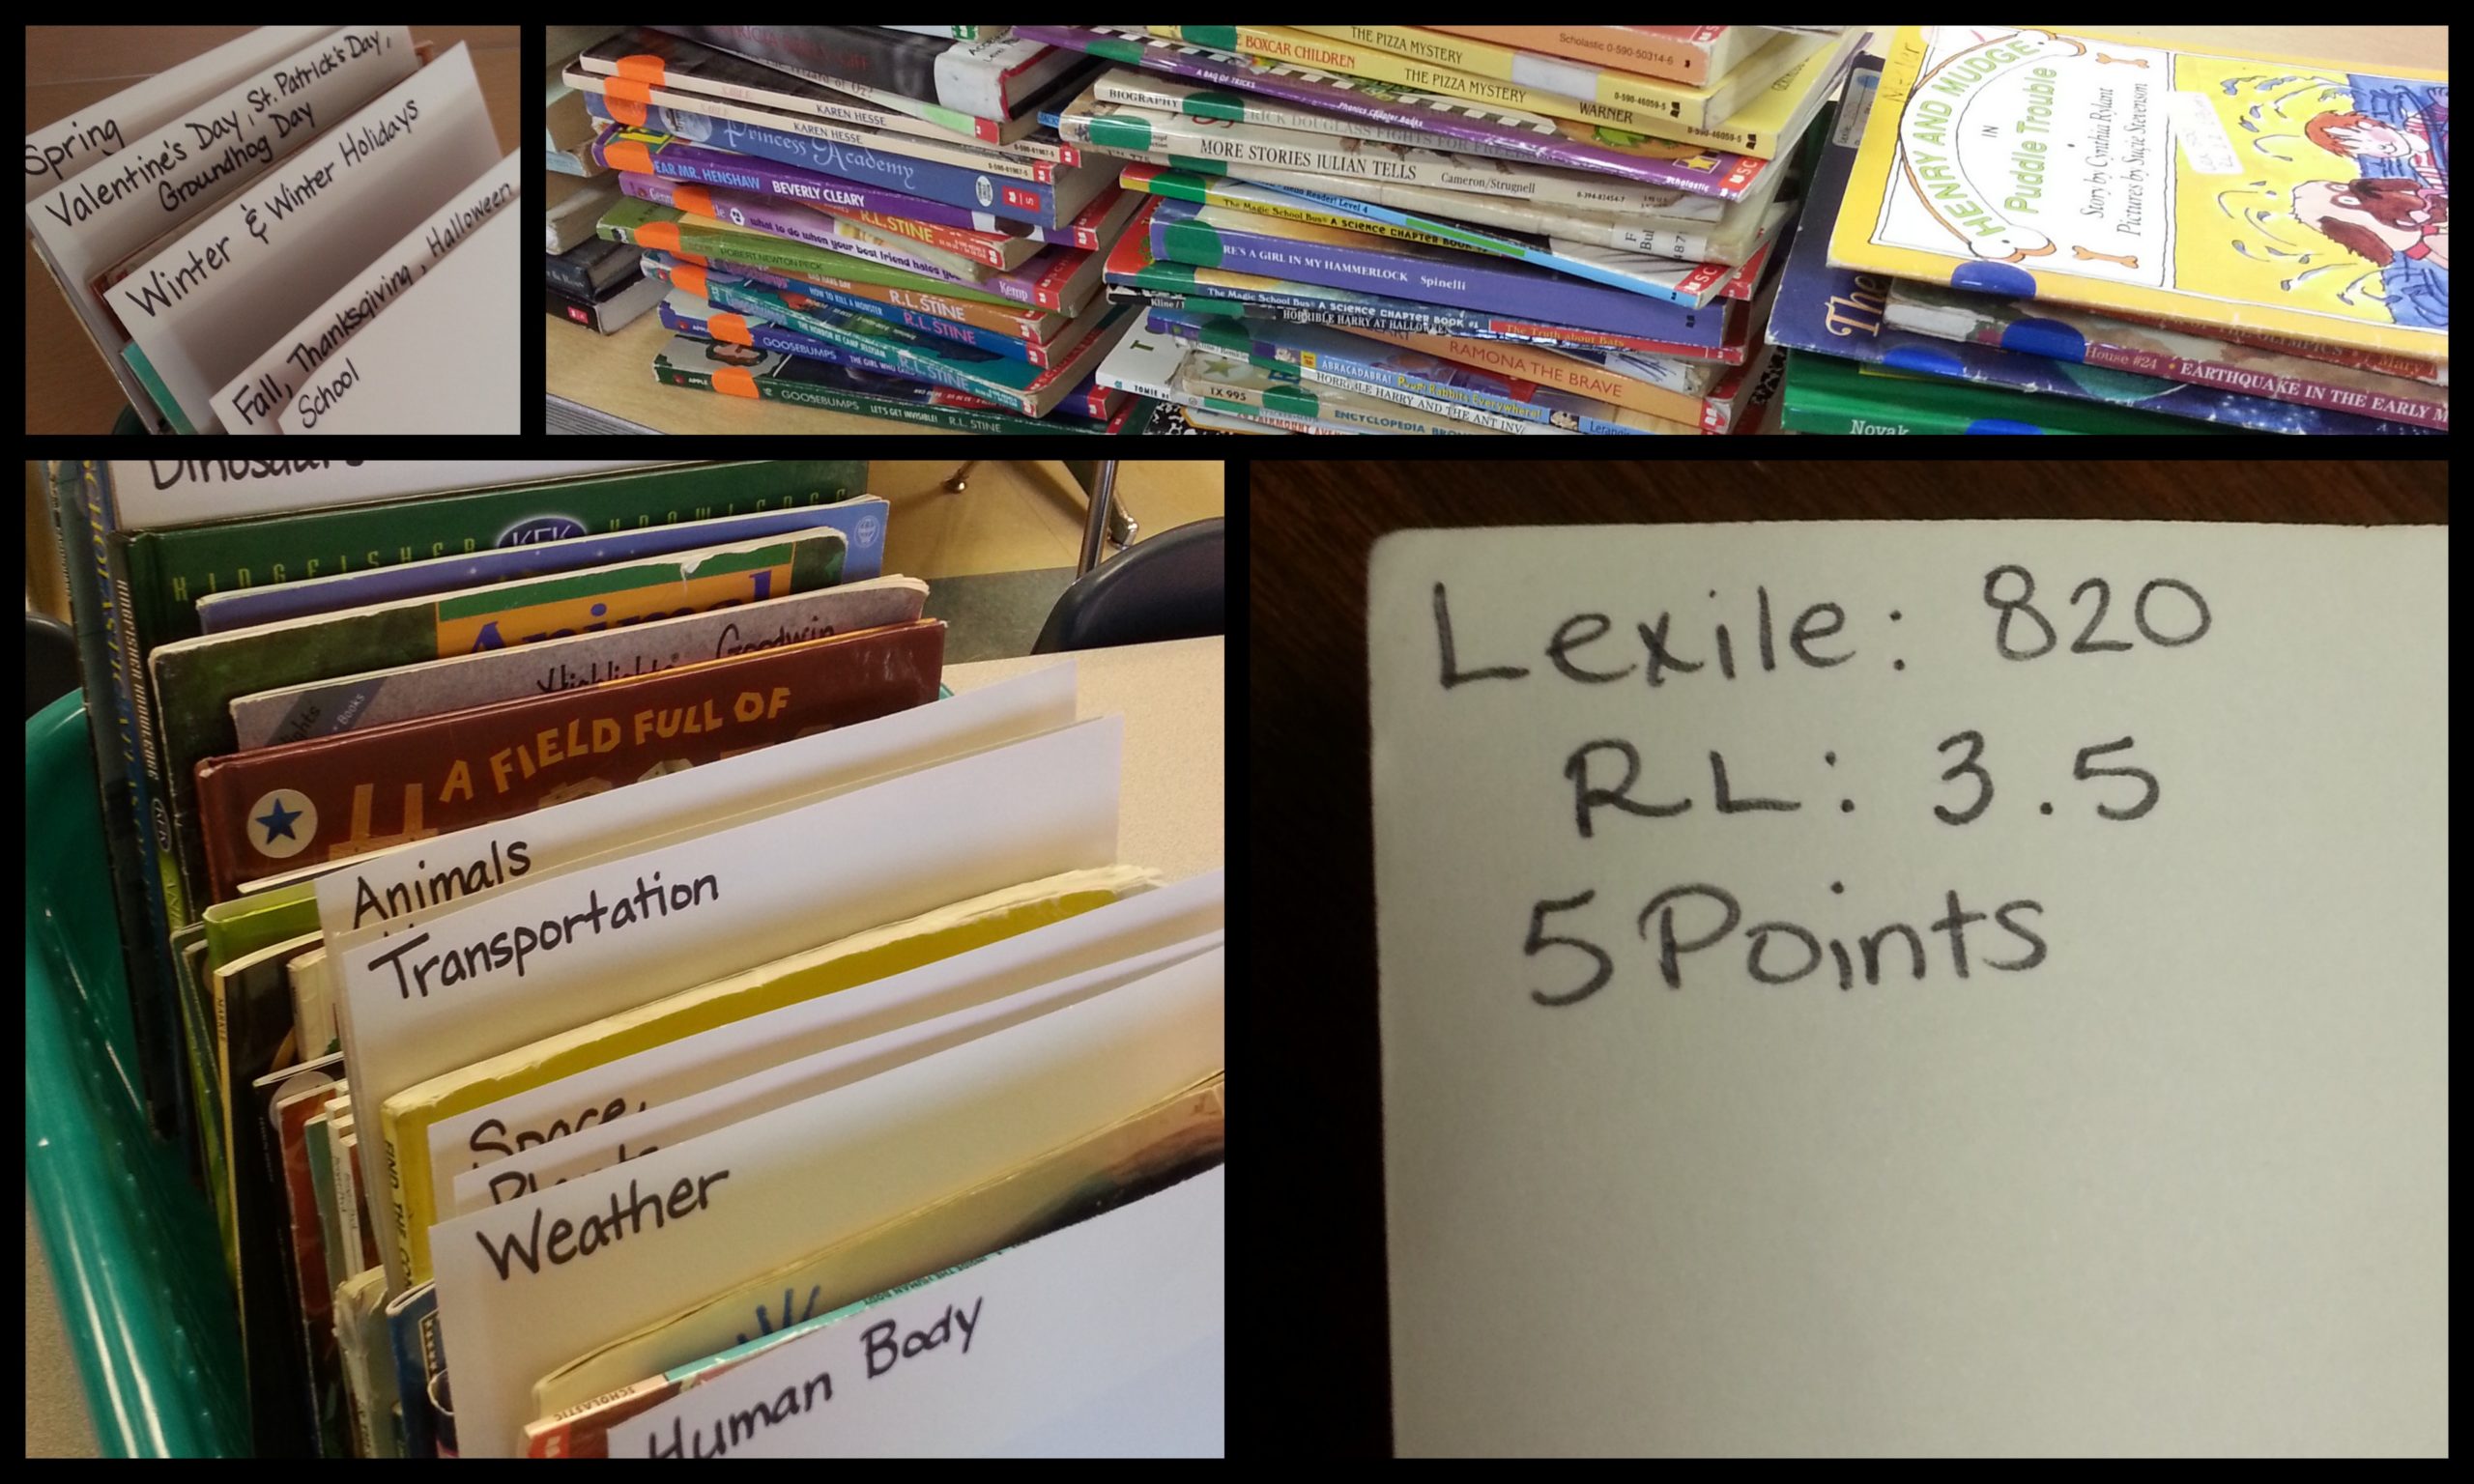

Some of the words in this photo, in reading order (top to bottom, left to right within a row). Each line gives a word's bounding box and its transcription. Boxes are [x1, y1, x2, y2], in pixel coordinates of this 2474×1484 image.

[1351, 27, 1373, 43] THE
[1376, 33, 1406, 51] PIZZA
[1410, 41, 1463, 65] MYSTERY
[1560, 33, 1604, 52] Scholastic
[1606, 43, 1674, 66] 0-590-50314-6
[1931, 40, 2040, 98] MUDGE
[1246, 36, 1291, 55] BOXCAR
[1295, 45, 1355, 69] CHILDREN
[1404, 68, 1428, 84] THE
[1433, 73, 1465, 92] PIZZA
[1468, 80, 1527, 104] MYSTERY
[1579, 101, 1633, 124] WARNER
[2016, 67, 2057, 133] Trouble
[2089, 87, 2117, 122] Rylant
[793, 122, 828, 137] KAREN
[831, 129, 863, 145] HESSE
[816, 104, 851, 121] KAREN
[855, 112, 887, 127] HESSE
[1109, 89, 1179, 107] BIOGRAPHY
[1292, 113, 1371, 136] DOUGLASS
[1377, 127, 1431, 146] FIGHTS
[1231, 77, 1255, 89] TRICKS
[1666, 176, 1710, 192] Scholastic
[1913, 100, 1952, 146] AND
[1981, 125, 1999, 138] IN
[2123, 83, 2148, 135] Stevenson
[24, 118, 127, 182] Spring
[44, 140, 187, 228] Valentine's
[246, 88, 279, 114] St.
[274, 44, 346, 99] Patrick's
[158, 137, 273, 214] Groundhog
[270, 101, 315, 143] Day
[724, 120, 806, 156] Princess
[811, 138, 916, 190] Academy
[2086, 124, 2114, 169] Cynthia
[678, 164, 701, 180] MR.
[703, 170, 760, 189] HENSHAW
[772, 181, 820, 200] BEVERLY
[822, 188, 865, 207] CLEARY
[1200, 139, 1244, 158] MORE
[1248, 146, 1311, 167] STORIES
[1317, 155, 1366, 175] JULIAN
[1372, 160, 1417, 180] TELLS
[1441, 171, 1537, 194] Cameron/Strugnell
[2003, 140, 2048, 214] Puddle
[2083, 167, 2113, 187] by
[2120, 167, 2149, 189] by
[126, 233, 234, 319] Winter
[241, 203, 270, 246] &
[267, 160, 335, 223] Winter
[338, 98, 420, 167] Holidays
[425, 180, 514, 258] Halloween
[1223, 199, 1240, 209] The
[1243, 202, 1270, 214] Magic
[1272, 207, 1303, 220] School
[1307, 189, 1338, 205] Reader!
[1338, 198, 1360, 213] Level
[1913, 151, 2006, 237] HENRY
[2080, 186, 2111, 219] Story
[2116, 190, 2143, 237] Pictures
[720, 247, 760, 263] ROBERT
[762, 253, 798, 267] NEWTON
[750, 218, 773, 230] what
[788, 226, 799, 238] do
[802, 231, 828, 245] when
[831, 240, 854, 252] your
[856, 243, 878, 258] best
[879, 250, 910, 268] friend
[912, 260, 940, 275] hates
[999, 280, 1028, 301] Kemp
[1259, 251, 1286, 264] GIRL
[1288, 254, 1302, 266] IN
[1305, 258, 1323, 269] MY
[1325, 260, 1408, 282] HAMMERLOCK
[1421, 275, 1466, 291] Spinelli
[809, 287, 824, 298] HOW
[835, 295, 848, 306] KILL
[855, 301, 883, 316] MONSTER
[933, 321, 976, 344] STINE
[920, 298, 965, 321] STINE
[1150, 298, 1174, 309] Kline
[1282, 310, 1335, 326] HORRIBLE
[1338, 312, 1371, 328] HARRY
[1373, 319, 1387, 328] AT
[1208, 287, 1225, 298] The
[1227, 291, 1255, 301] Magic
[1258, 294, 1290, 306] School
[1433, 315, 1464, 328] BOOK
[1506, 324, 1527, 335] The
[1530, 328, 1561, 339] Truth
[1563, 332, 1596, 343] about
[1598, 336, 1625, 348] Bats
[1825, 274, 1884, 337] The
[762, 337, 837, 360] GOOSEBUMPS
[1450, 340, 1527, 375] RAMONA
[1531, 361, 1564, 382] THE
[1569, 374, 1623, 397] BRAVE
[2378, 357, 2423, 375] Mary
[297, 357, 361, 432] School
[927, 366, 970, 391] STINE
[1134, 385, 1158, 397] TOMIE
[1322, 359, 1393, 385] ABRACADABRA!
[1429, 385, 1469, 402] Rabbits
[1472, 391, 1542, 419] Everywhere!
[2086, 345, 2130, 366] House
[2133, 354, 2158, 370] #24
[2180, 361, 2300, 397] EARTHQUAKE
[2305, 383, 2325, 400] IN
[2330, 388, 2367, 408] THE
[2372, 396, 2431, 419] EARLY
[781, 388, 860, 411] GOOSEBUMPS
[870, 405, 889, 417] LET'S
[890, 408, 903, 418] GET
[904, 410, 938, 423] INVISIBLE!
[970, 419, 1002, 434] STINE
[1226, 386, 1247, 401] 995
[1335, 410, 1425, 434] ENCYCLOPEDIA
[1375, 388, 1415, 406] HARRY
[1418, 399, 1443, 414] AND
[1445, 406, 1470, 422] THE
[1474, 415, 1498, 428] ANT
[1850, 419, 1910, 435] Novak
[1432, 584, 1908, 689] Lexile:
[1981, 564, 2213, 663] 820
[337, 692, 366, 726] Books
[439, 759, 474, 803] A
[489, 718, 621, 793] FIELD
[634, 699, 723, 745] FULL
[734, 687, 791, 722] OF
[1933, 730, 2161, 825] 3.5
[354, 842, 531, 929] Animals
[369, 871, 719, 998] Transportation
[1523, 889, 1615, 1006] 5
[1638, 882, 2048, 991] Points
[475, 1170, 730, 1280] Weather
[555, 1384, 637, 1423] SCHOLASTIC
[647, 1372, 833, 1460] Human
[859, 1297, 983, 1380] Body
